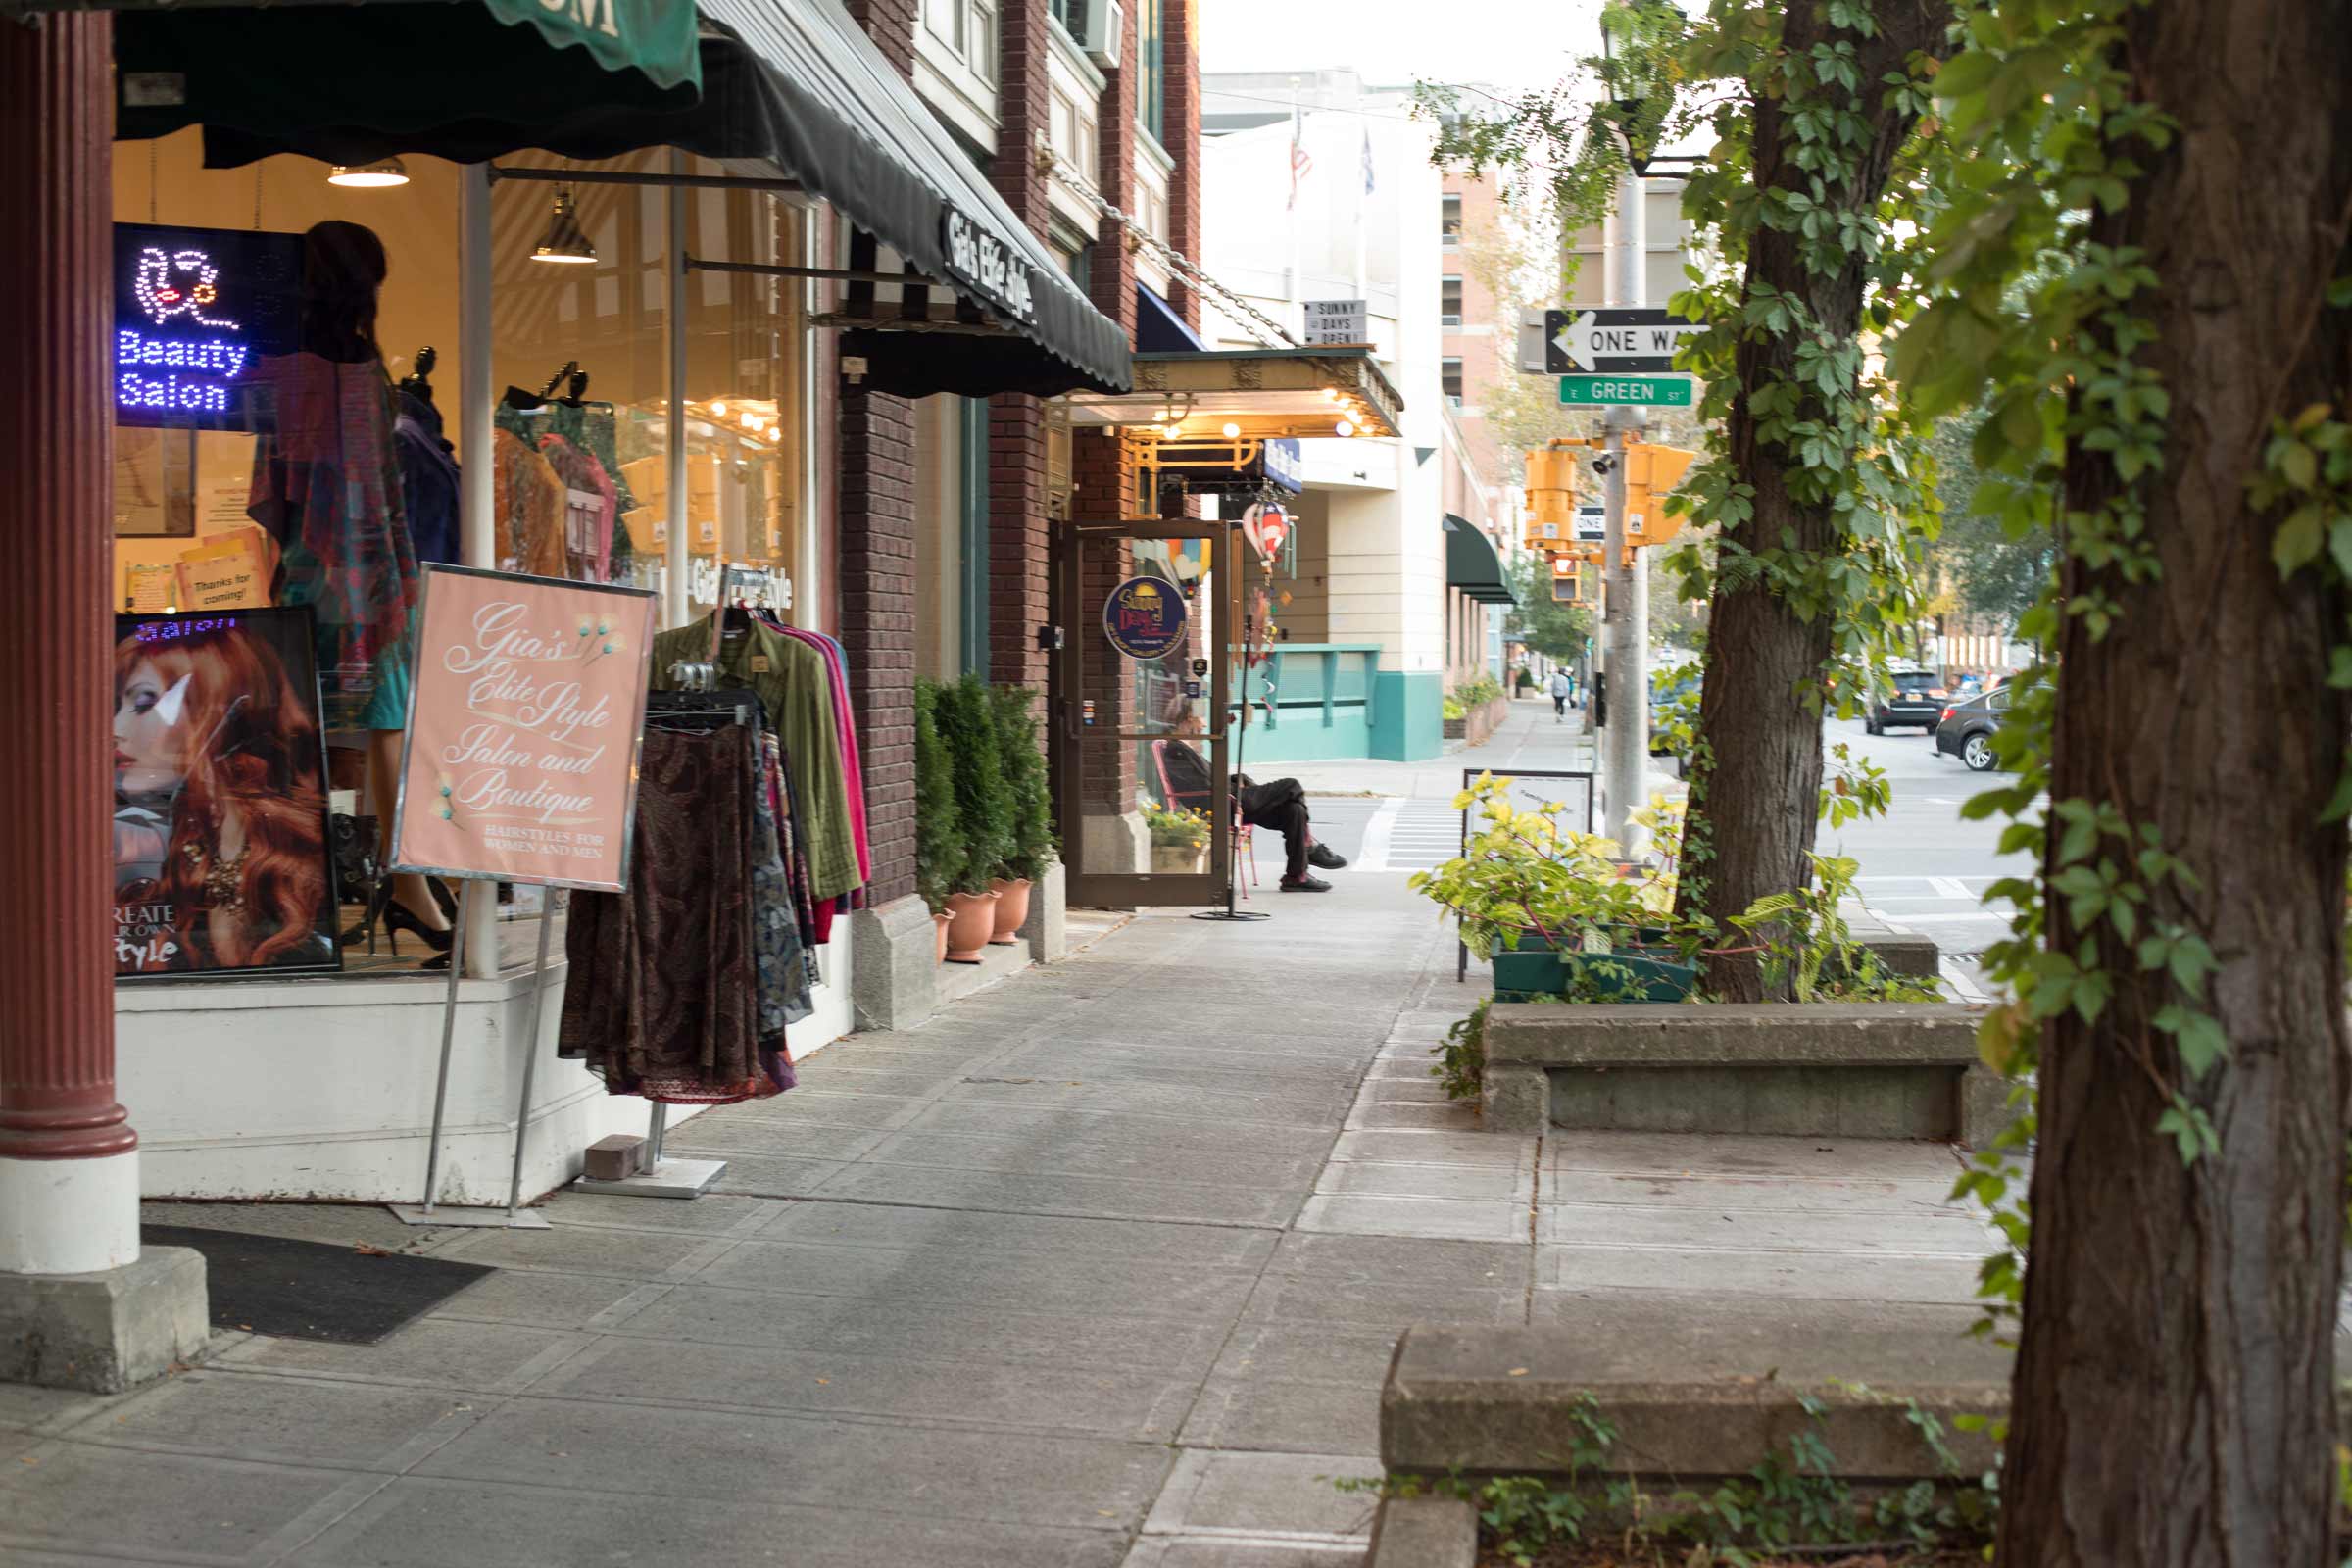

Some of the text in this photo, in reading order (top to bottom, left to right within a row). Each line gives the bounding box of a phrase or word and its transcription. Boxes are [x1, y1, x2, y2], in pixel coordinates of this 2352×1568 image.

[1318, 303, 1356, 315] SUNNY
[1321, 318, 1351, 330] DAYS
[1590, 330, 1637, 352] ONE
[119, 330, 247, 377] Beauty
[119, 373, 226, 410] Salon
[1591, 381, 1655, 401] GREEN
[1577, 517, 1602, 529] ONE
[194, 572, 252, 592] Thanks for
[203, 590, 245, 606] coming!
[443, 601, 569, 674] Gia's
[466, 661, 612, 742] Elite Style
[442, 722, 606, 775] Salon and
[456, 767, 596, 824] Boutique
[484, 823, 605, 847] HAIRSTYLES FOR
[483, 837, 603, 858] WOMEN AND MEN
[112, 905, 174, 923] REATE
[113, 938, 178, 971] tyle
